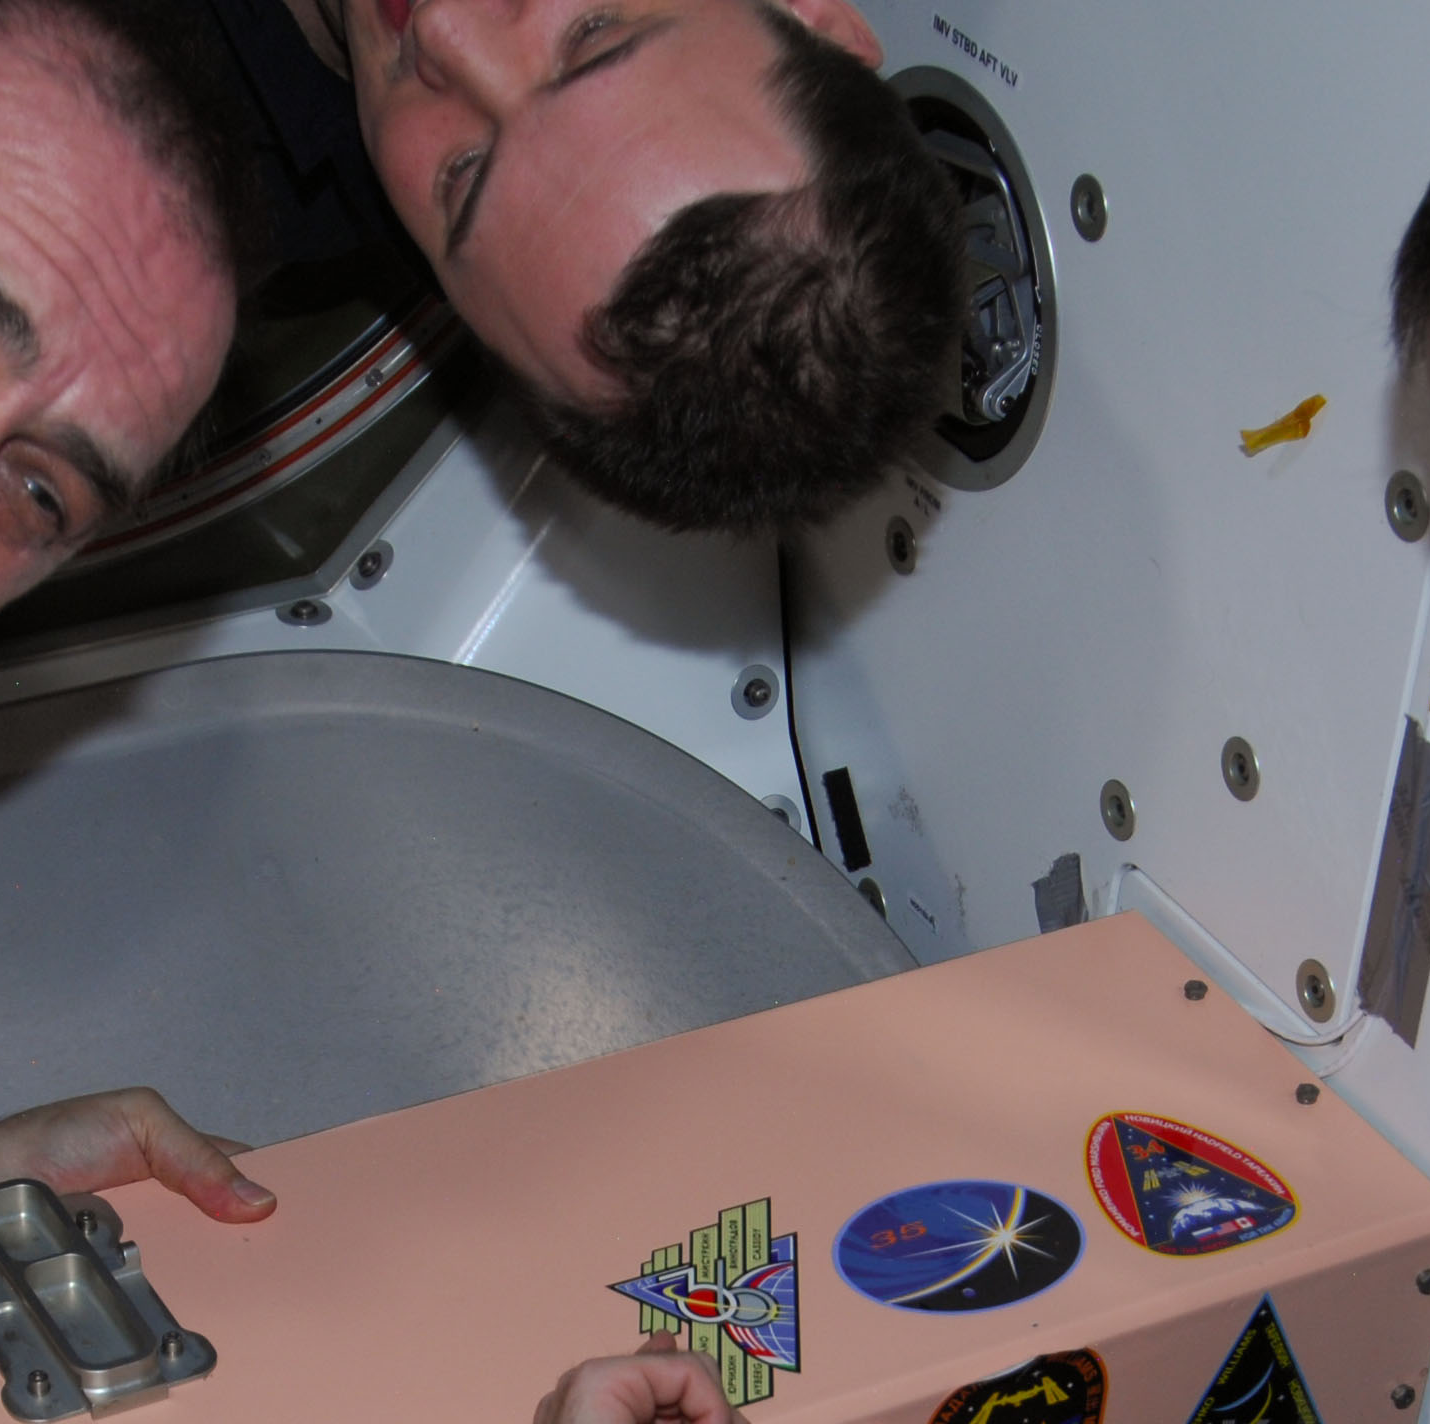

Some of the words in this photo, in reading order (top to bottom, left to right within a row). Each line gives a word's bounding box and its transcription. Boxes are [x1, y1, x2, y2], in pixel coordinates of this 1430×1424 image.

[933, 14, 951, 38] IMV
[952, 28, 978, 58] STBD
[979, 48, 998, 73] AFT
[1000, 61, 1018, 87] VLV
[1193, 1131, 1243, 1159] HADFIELD
